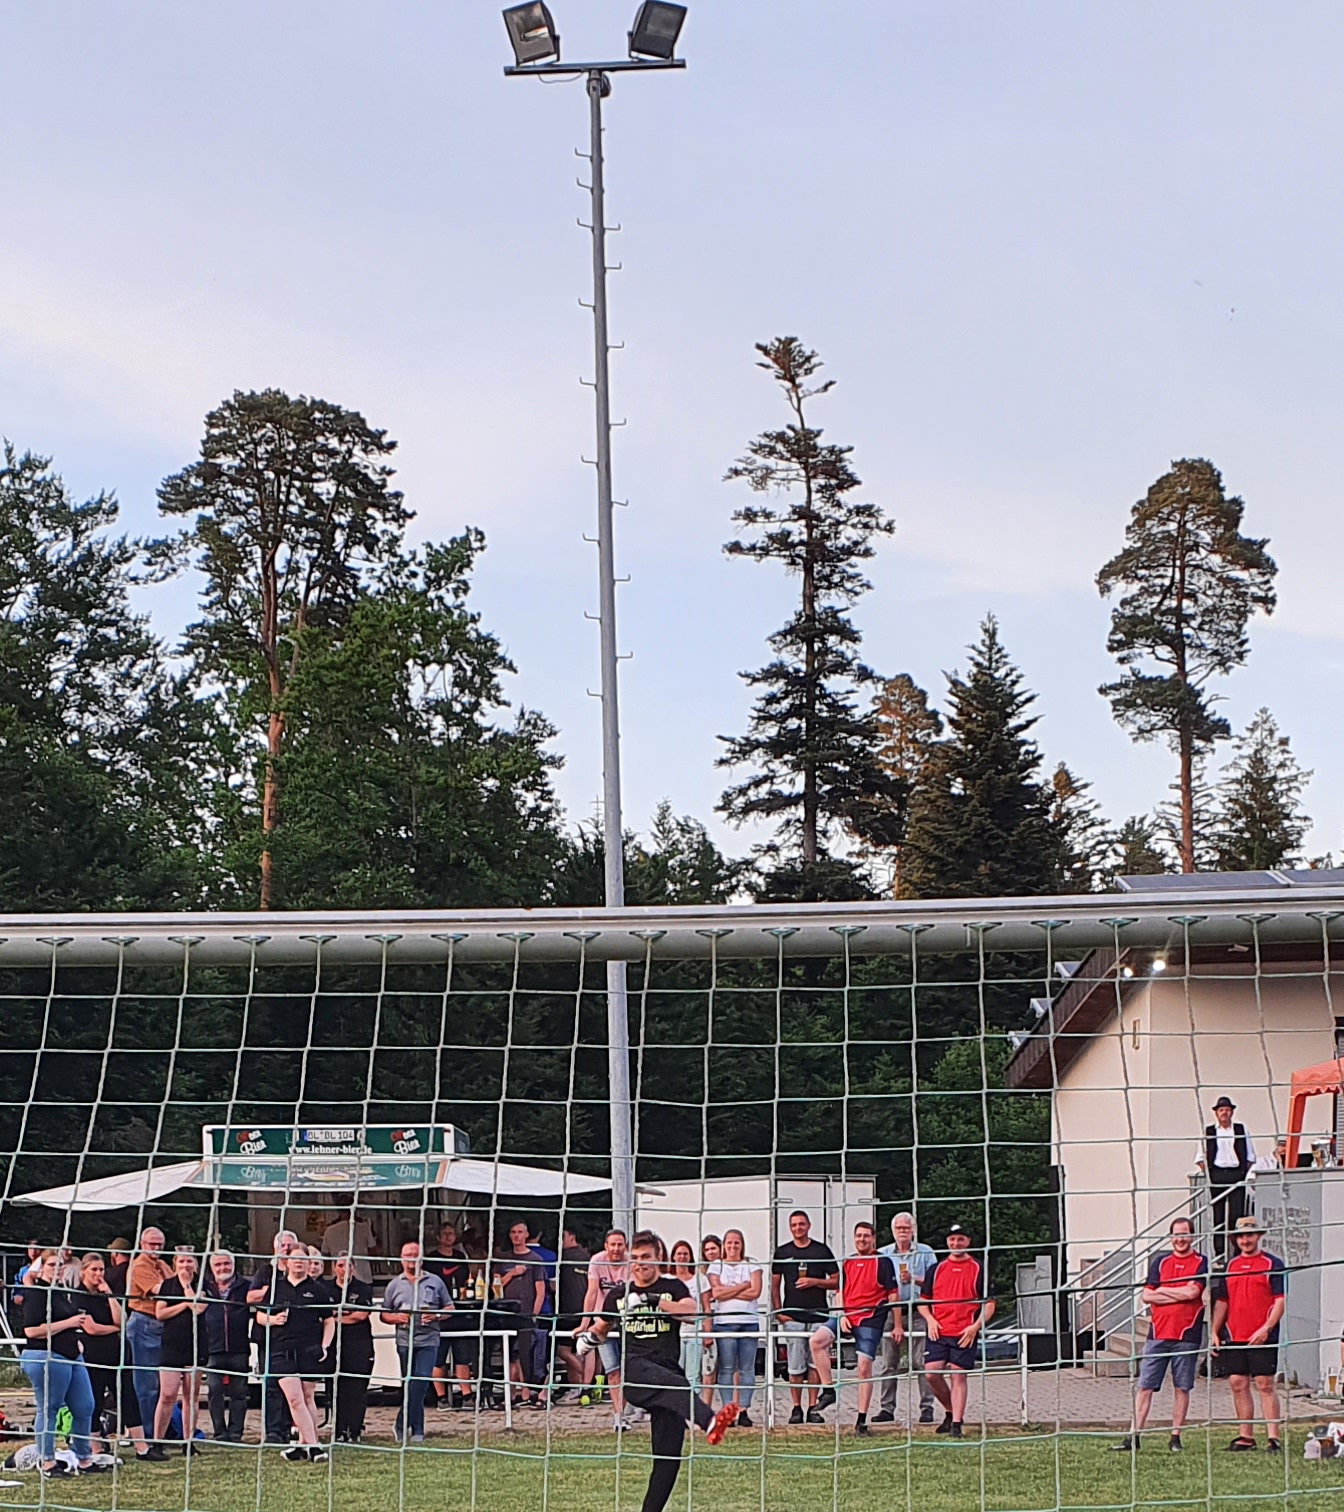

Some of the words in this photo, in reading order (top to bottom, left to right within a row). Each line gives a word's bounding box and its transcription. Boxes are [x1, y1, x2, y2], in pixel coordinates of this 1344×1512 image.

[338, 1131, 353, 1140] 104
[240, 1139, 267, 1154] Bier
[288, 1144, 372, 1155] www.lehner-bier.de
[394, 1139, 421, 1154] Bier
